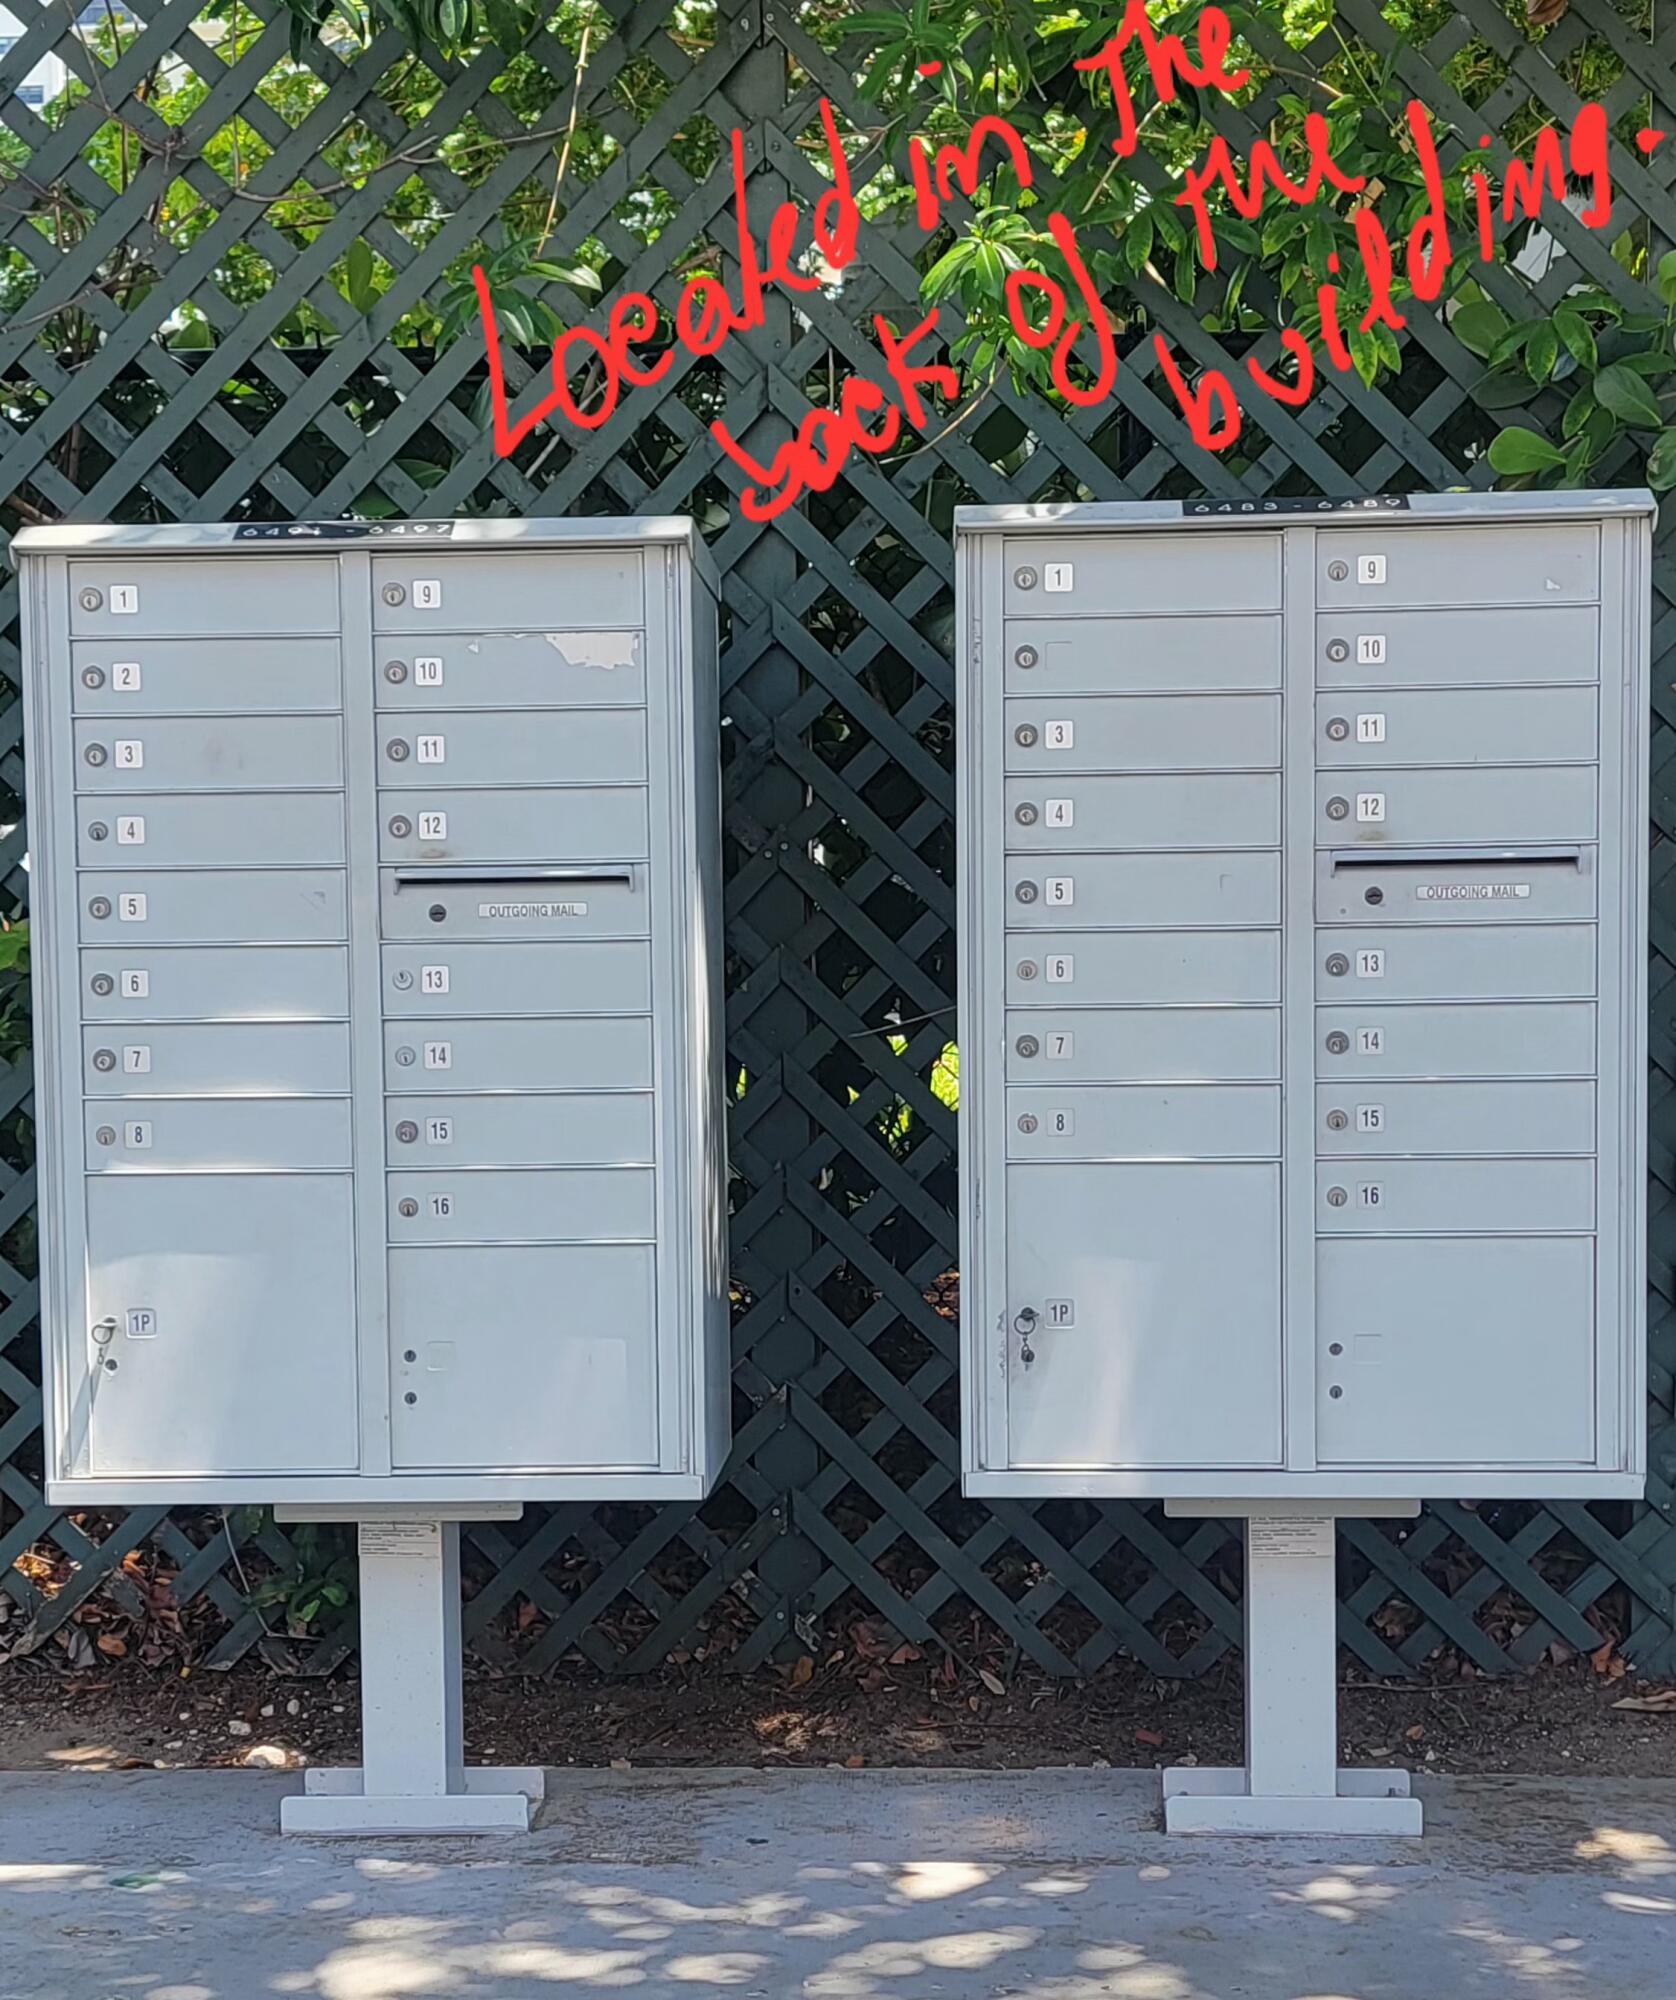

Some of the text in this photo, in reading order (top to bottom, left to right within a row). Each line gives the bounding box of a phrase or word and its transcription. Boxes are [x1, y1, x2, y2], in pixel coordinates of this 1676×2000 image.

[1054, 568, 1063, 587] 1
[1367, 560, 1377, 580] 9
[119, 590, 128, 608] 1
[422, 585, 432, 604] 9
[1362, 639, 1381, 659] 10
[120, 667, 131, 686] 2
[419, 661, 437, 681] 10
[1054, 725, 1065, 744] 3
[1361, 718, 1380, 738] 11
[123, 745, 134, 764] 3
[421, 739, 440, 758] 11
[1054, 804, 1065, 823] 4
[1361, 797, 1380, 817] 12
[125, 821, 136, 840] 4
[423, 816, 442, 835] 12
[1054, 882, 1064, 901] 5
[1425, 885, 1520, 899] OUTGOING MAIL
[127, 897, 137, 917] 5
[488, 903, 580, 919] OUTGOING MAIL
[1055, 959, 1065, 979] 6
[1360, 954, 1380, 973] 13
[130, 974, 140, 993] 6
[425, 970, 444, 989] 13
[1055, 1037, 1065, 1055] 7
[1361, 1032, 1380, 1051] 14
[131, 1050, 142, 1069] 7
[429, 1046, 447, 1065] 14
[1055, 1113, 1065, 1133] 8
[1361, 1109, 1380, 1128] 15
[134, 1125, 143, 1145] 8
[430, 1121, 449, 1141] 15
[1361, 1186, 1380, 1205] 16
[431, 1197, 450, 1216] 16
[1049, 1303, 1069, 1323] 1P
[131, 1313, 152, 1333] 1P
